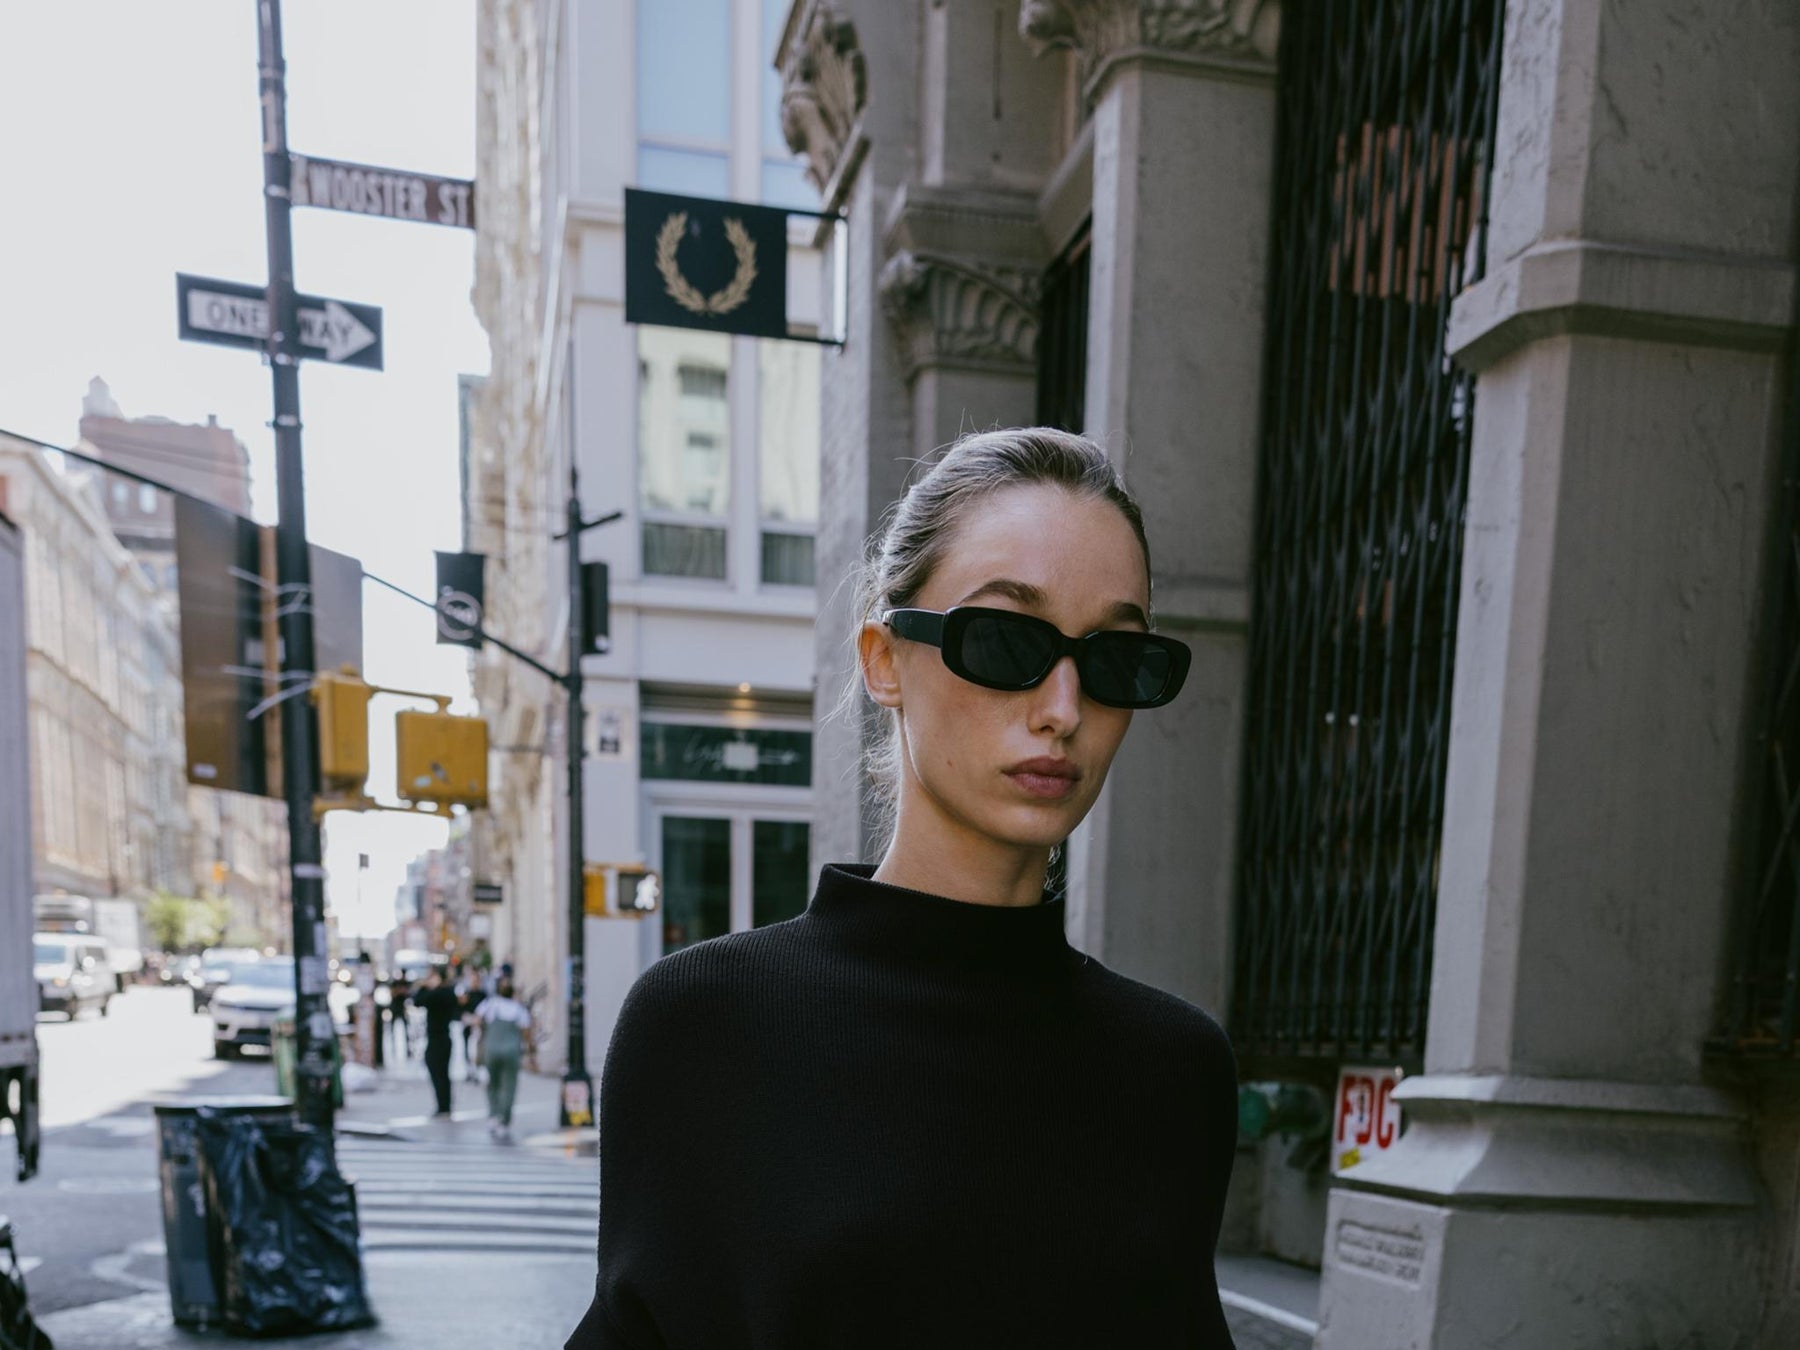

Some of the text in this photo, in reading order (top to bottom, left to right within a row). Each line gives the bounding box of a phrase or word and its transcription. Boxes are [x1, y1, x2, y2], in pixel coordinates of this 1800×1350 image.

[308, 163, 470, 227] WOOSTER ST
[206, 298, 265, 331] ONE
